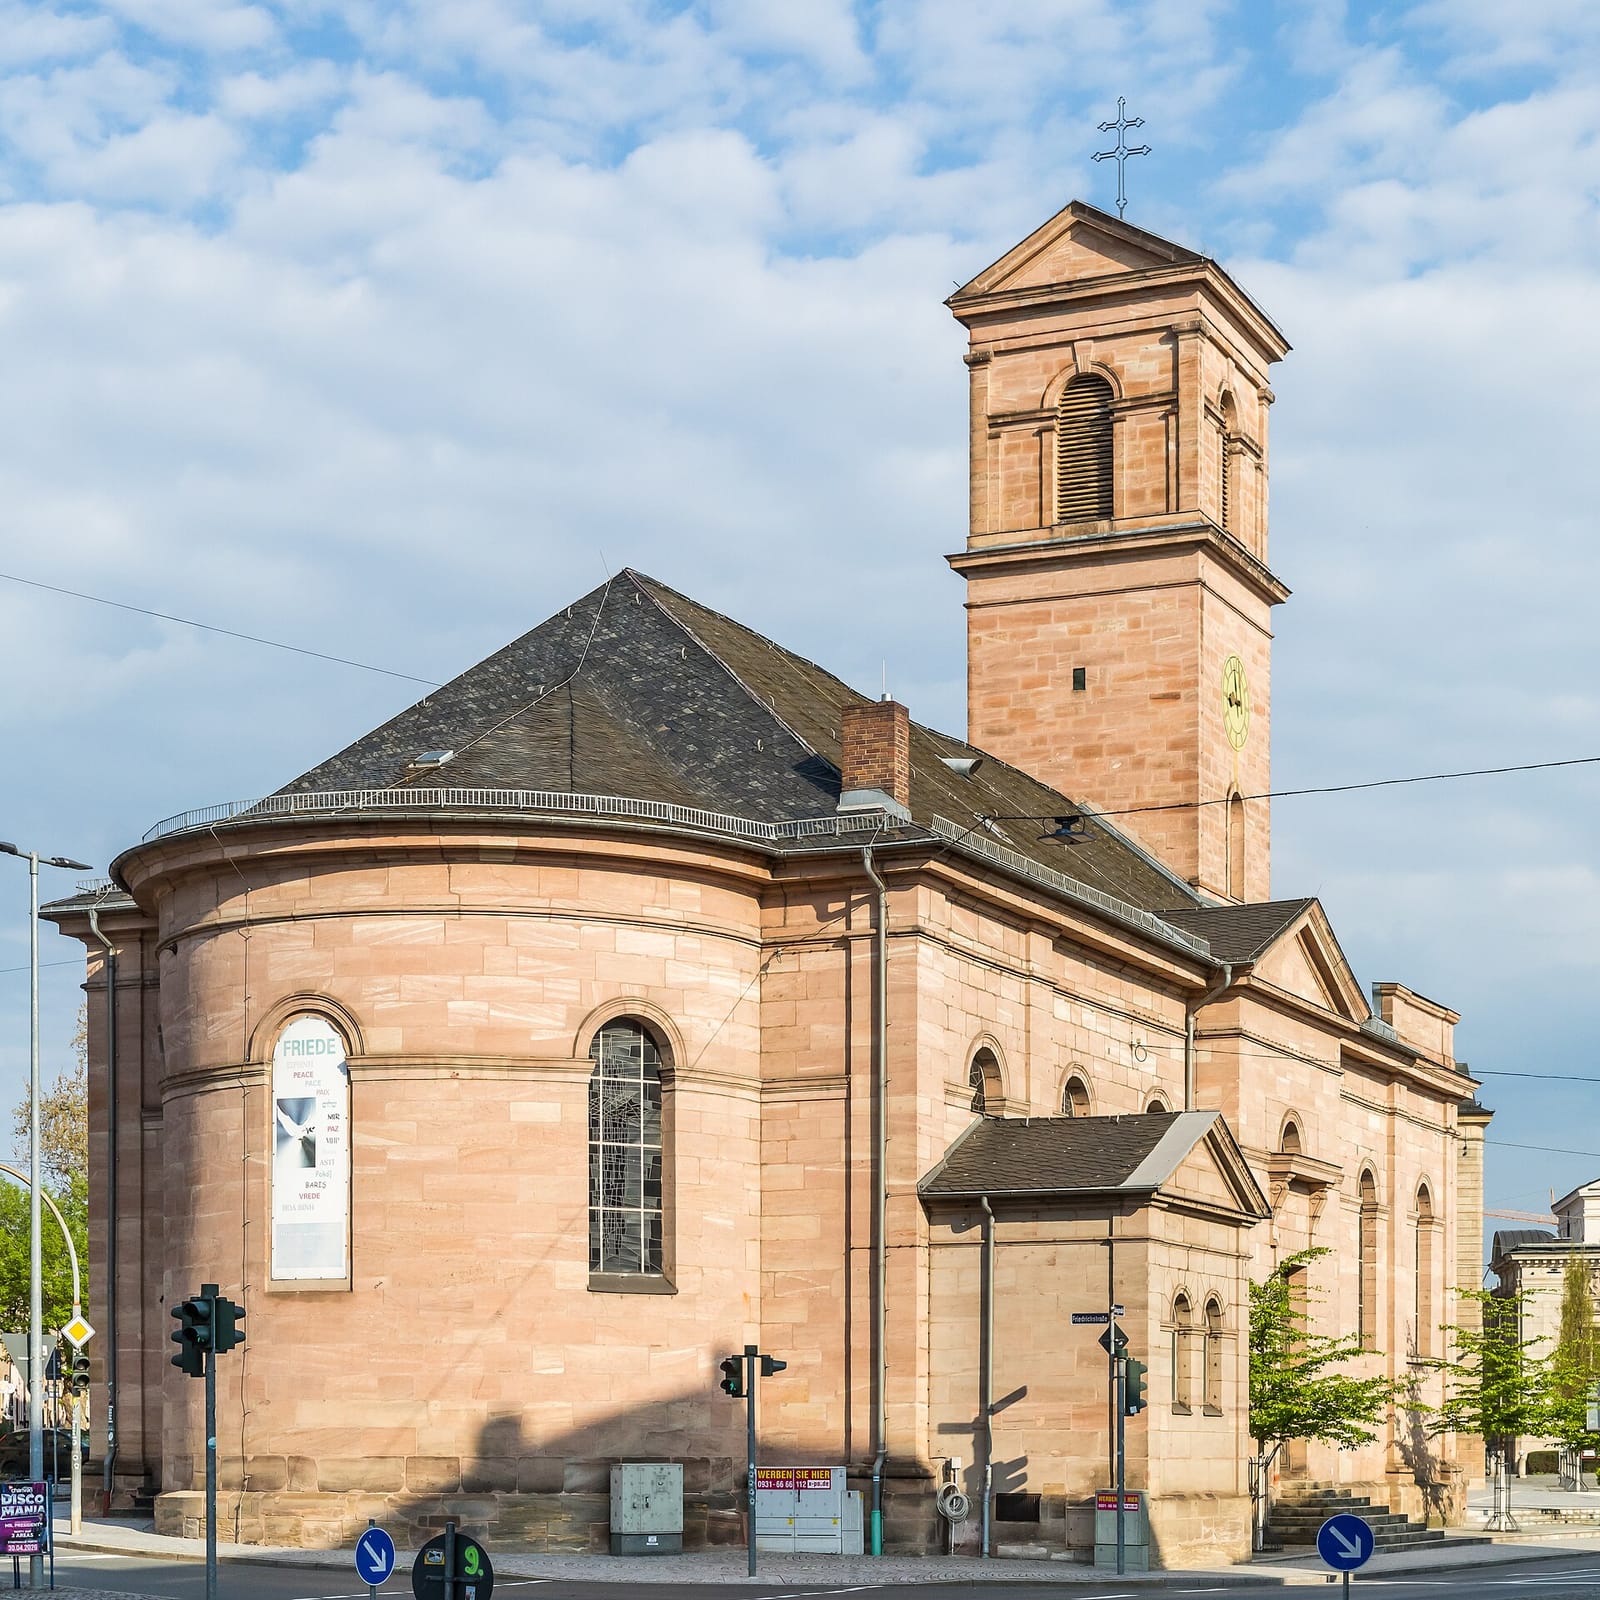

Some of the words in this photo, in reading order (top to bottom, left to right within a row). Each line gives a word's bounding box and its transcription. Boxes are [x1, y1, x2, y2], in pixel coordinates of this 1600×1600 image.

[283, 1038, 336, 1056] FRIEDE
[757, 1470, 793, 1479] WERBEN
[796, 1470, 809, 1479] SIE
[811, 1470, 830, 1479] HIER
[1, 1494, 44, 1505] DISCO
[2, 1505, 45, 1517] MANIA
